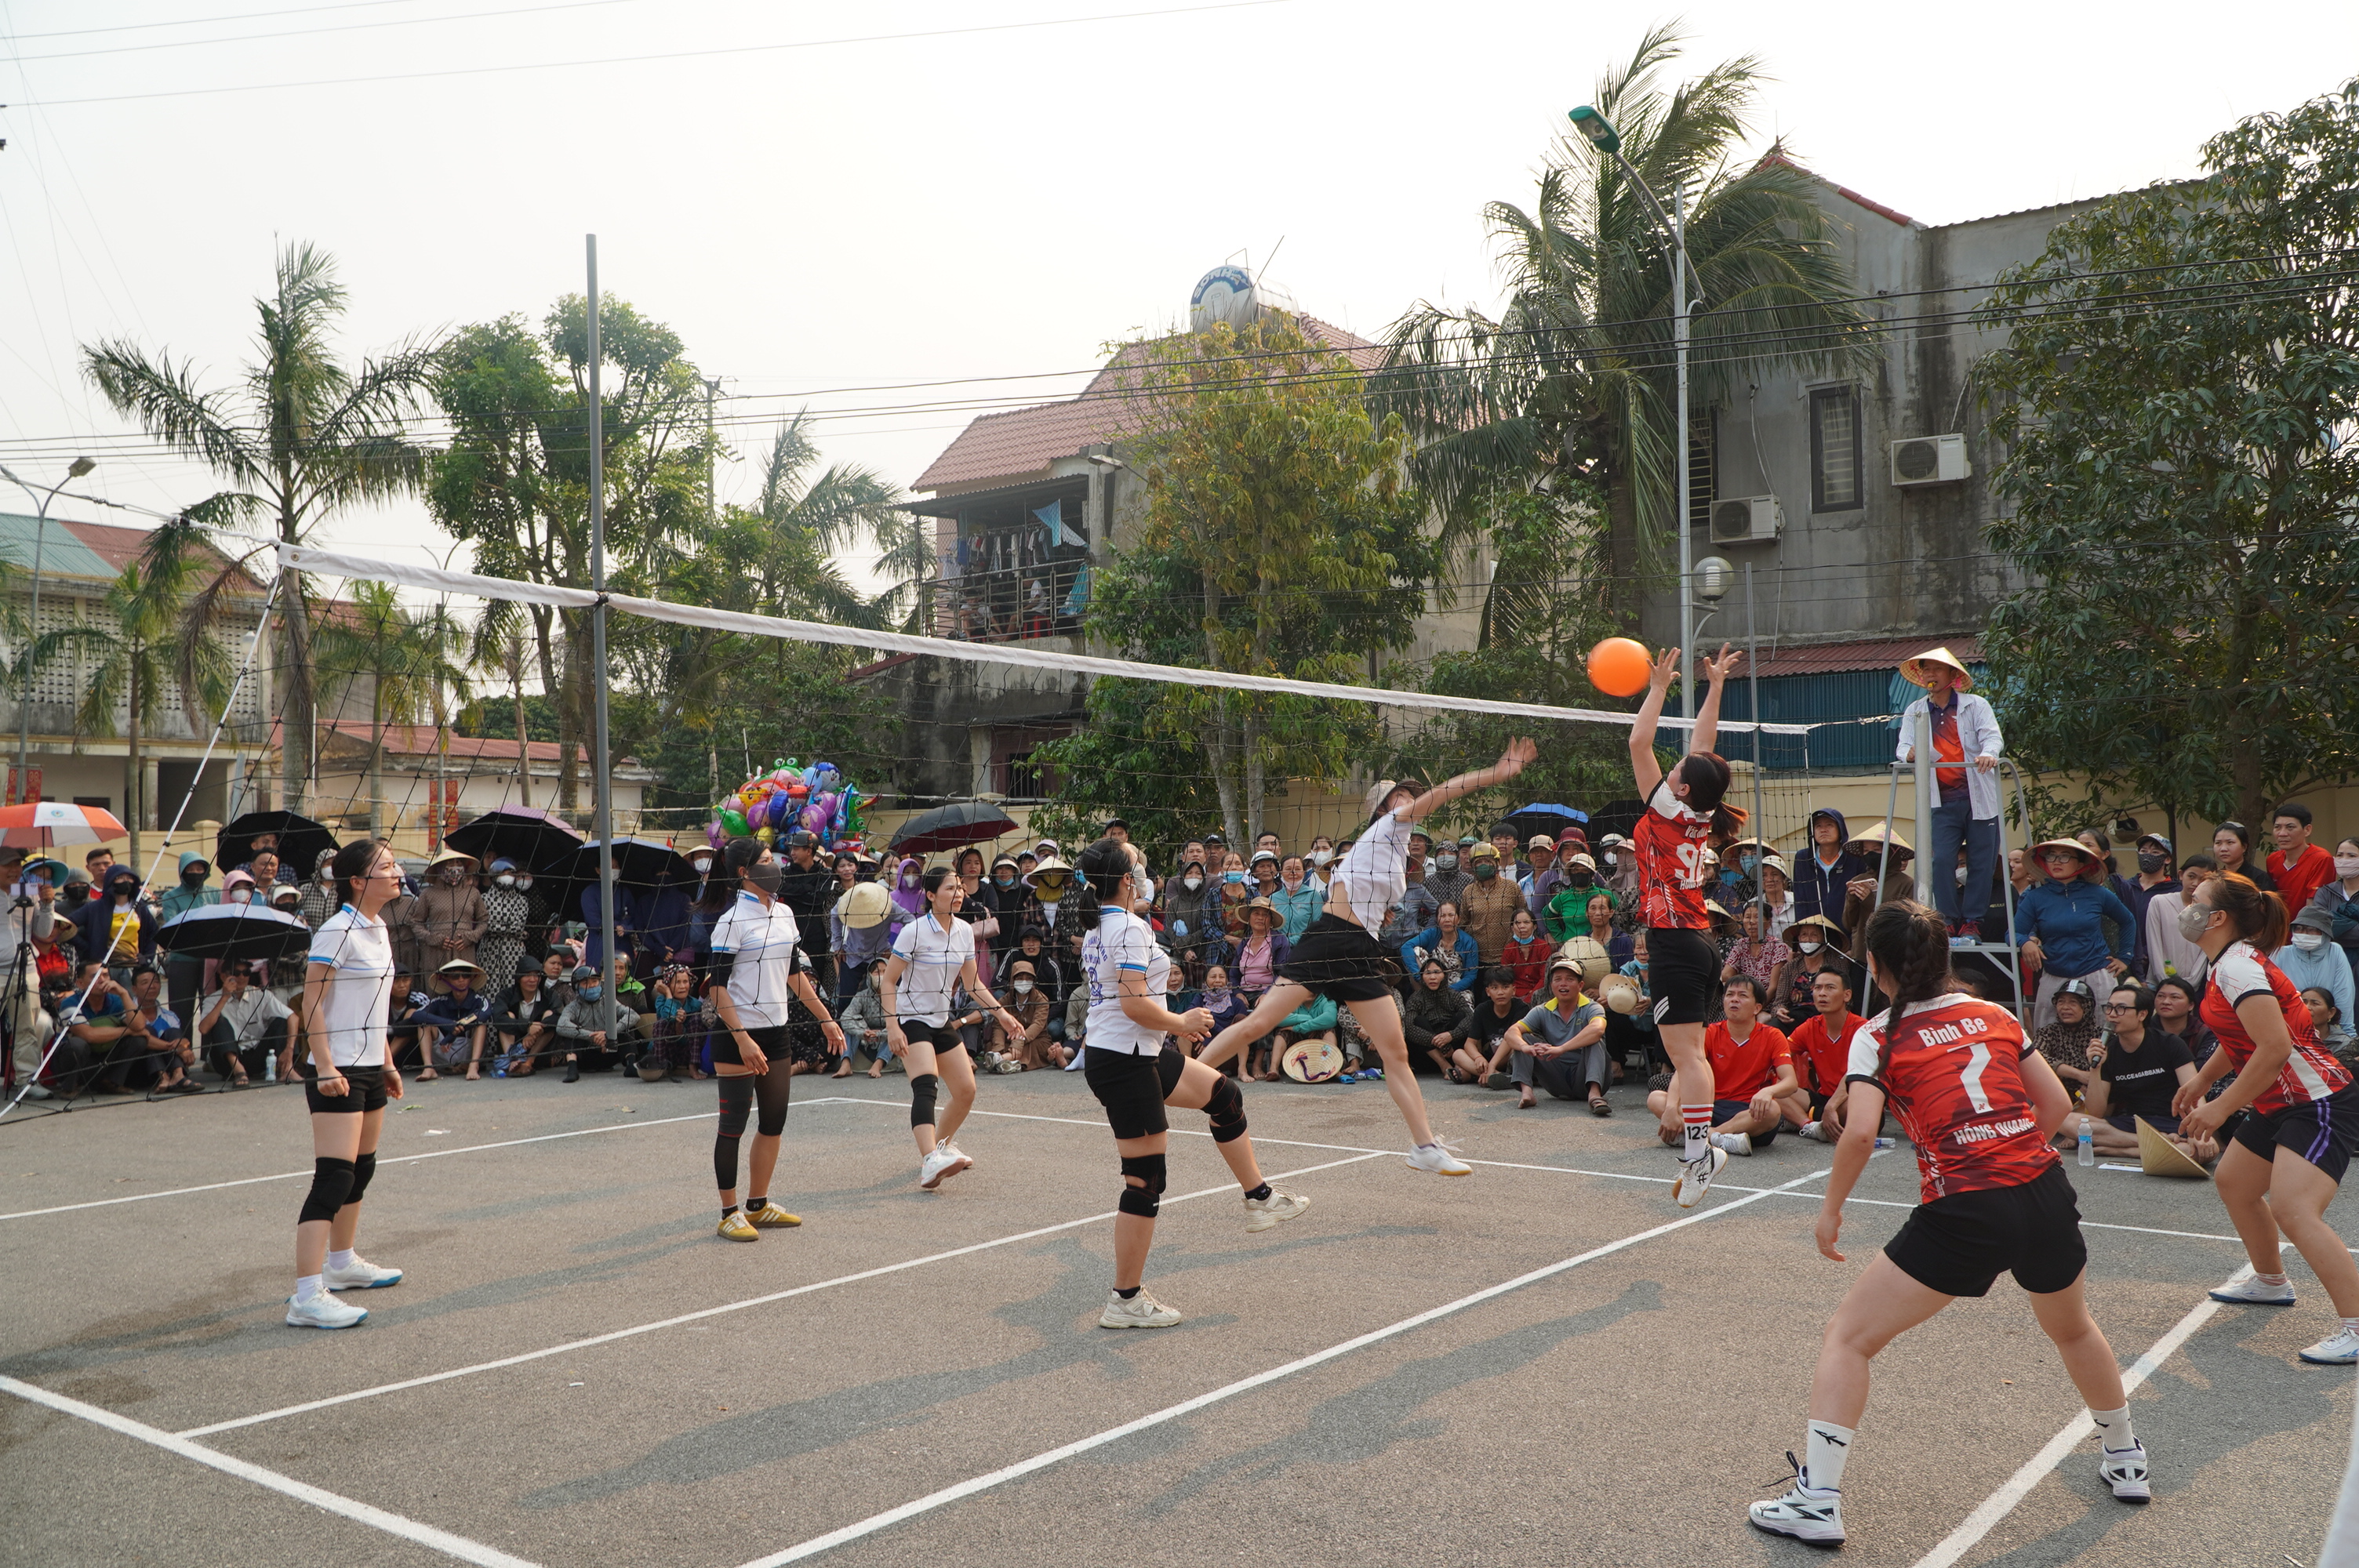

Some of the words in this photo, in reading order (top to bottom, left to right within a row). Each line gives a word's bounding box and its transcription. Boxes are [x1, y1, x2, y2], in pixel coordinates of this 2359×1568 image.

[1917, 1023, 1964, 1047] Bình
[1960, 1018, 1988, 1035] Be
[1946, 1042, 1995, 1114] 7
[2115, 1067, 2165, 1081] DOLCE&GABBANA
[1686, 1124, 1709, 1141] 123
[1953, 1122, 1997, 1145] HỒNG
